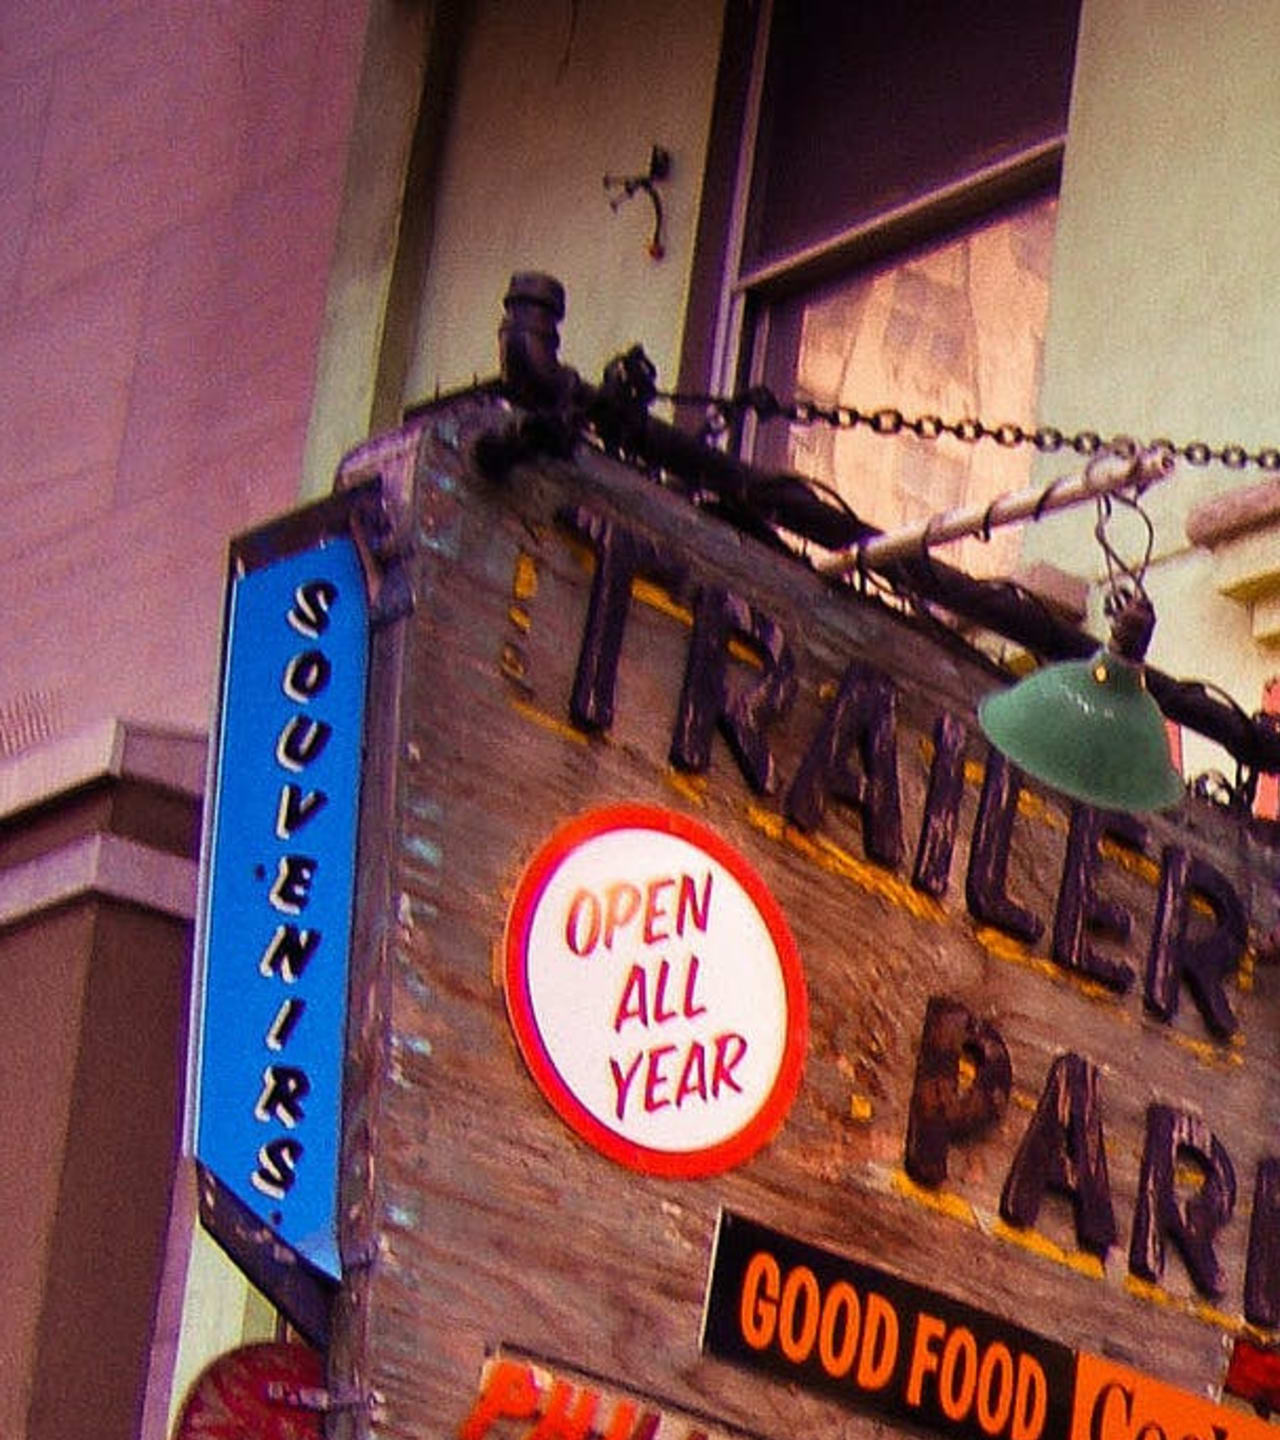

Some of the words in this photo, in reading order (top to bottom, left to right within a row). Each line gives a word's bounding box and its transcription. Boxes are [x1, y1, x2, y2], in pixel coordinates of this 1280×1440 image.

[555, 503, 1256, 1040] TRAILER
[251, 581, 338, 1199] SOUVENIRS
[565, 873, 713, 958] OPEN
[614, 956, 707, 1029] ALL
[609, 1033, 749, 1122] YEAR
[740, 1249, 898, 1392] GOOD
